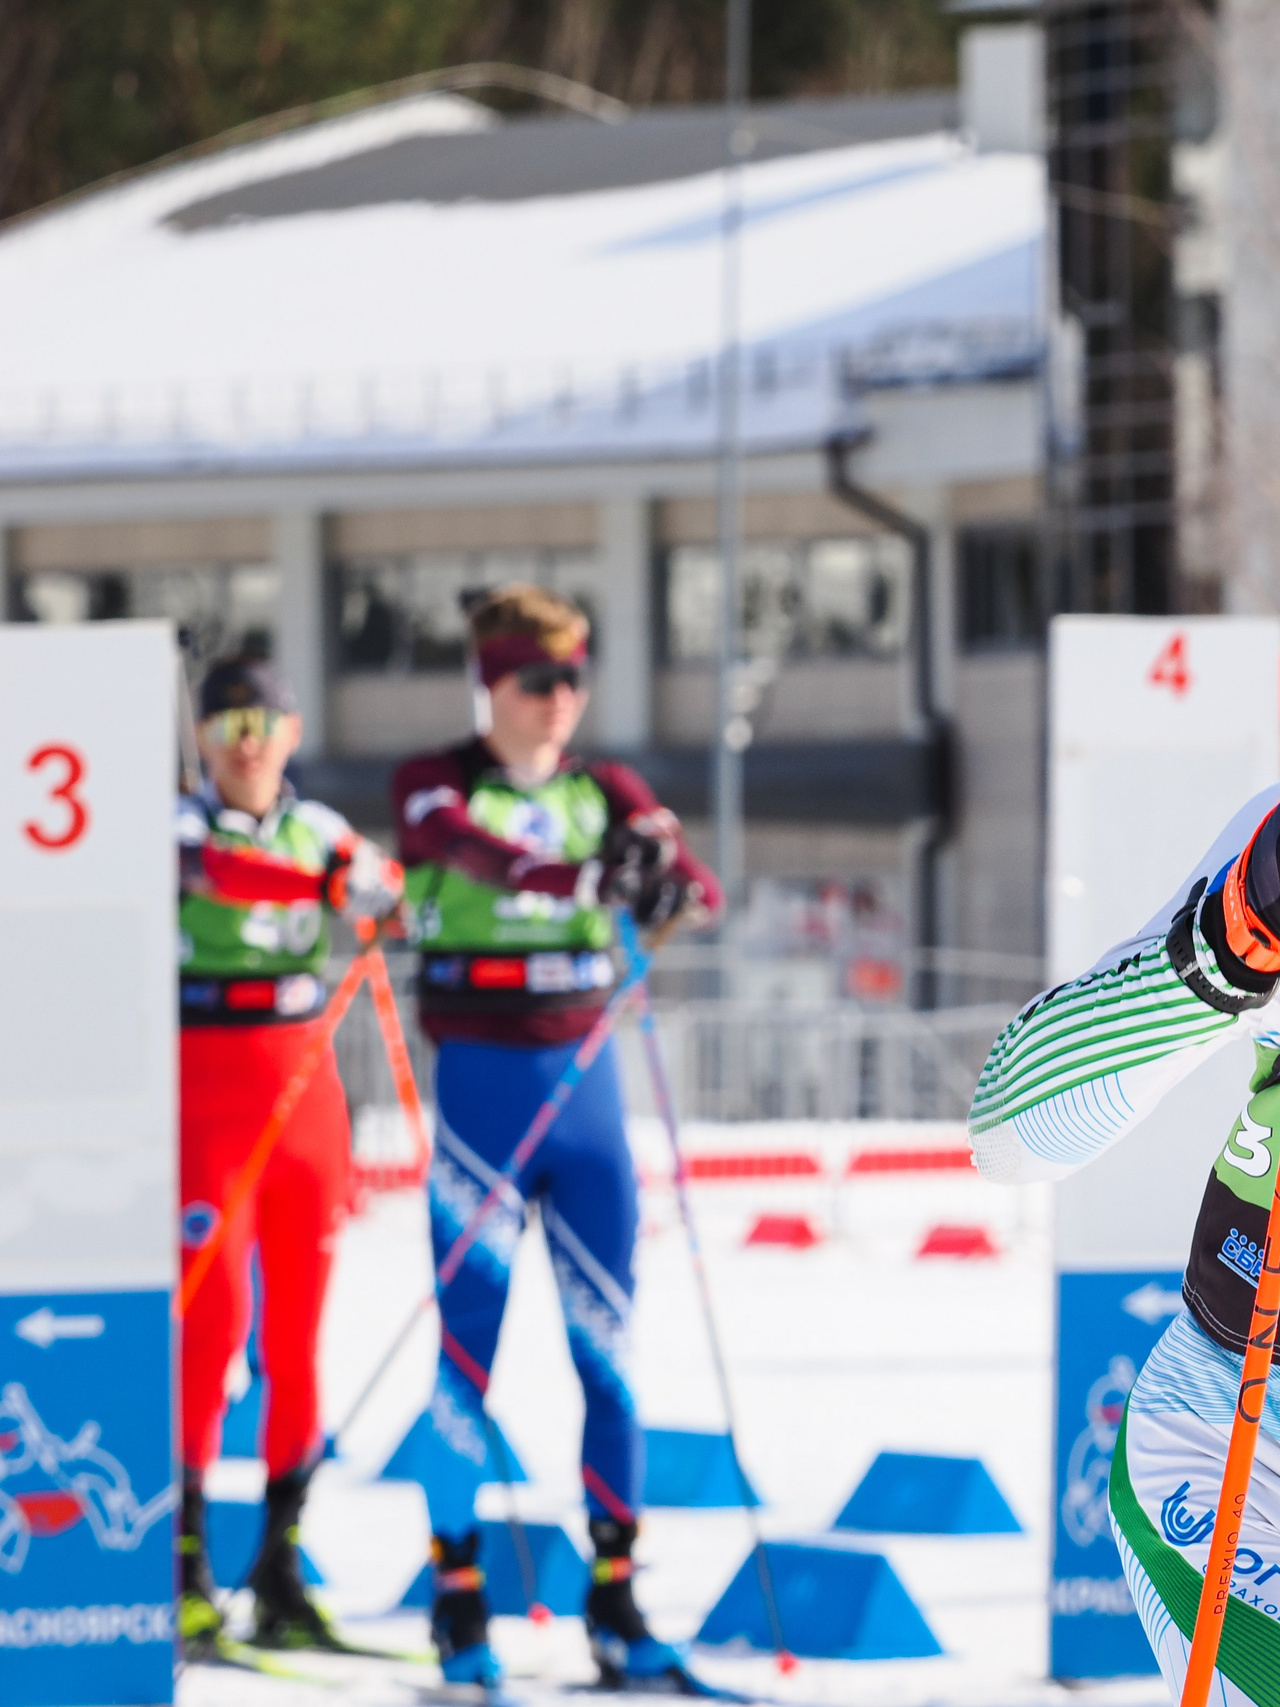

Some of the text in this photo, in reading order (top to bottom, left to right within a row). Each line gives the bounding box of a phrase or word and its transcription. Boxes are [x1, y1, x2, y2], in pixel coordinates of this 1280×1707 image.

[1148, 632, 1191, 698] 4
[25, 743, 90, 853] 3
[1213, 1493, 1246, 1615] PREMIO 40
